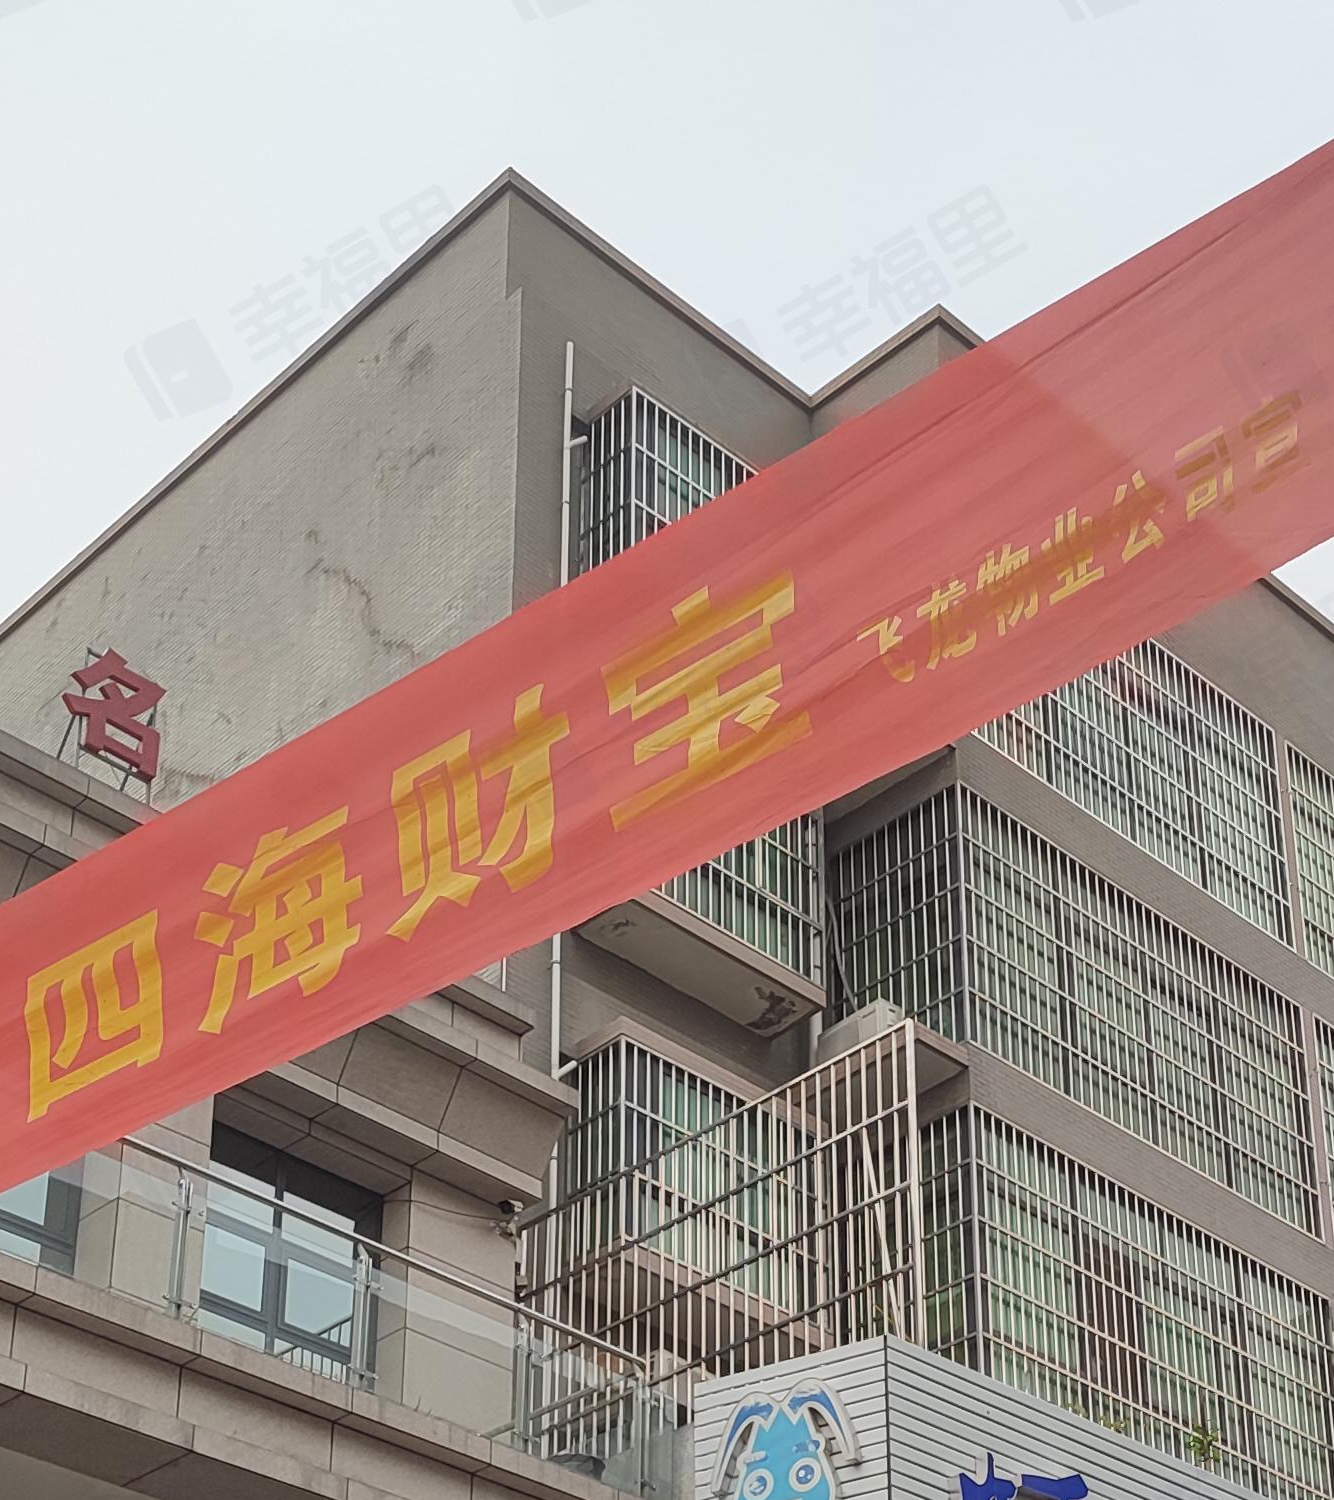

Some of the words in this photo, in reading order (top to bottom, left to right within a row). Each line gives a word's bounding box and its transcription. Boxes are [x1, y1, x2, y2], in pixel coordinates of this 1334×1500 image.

[856, 392, 1305, 686] 飞龙物业公司宣
